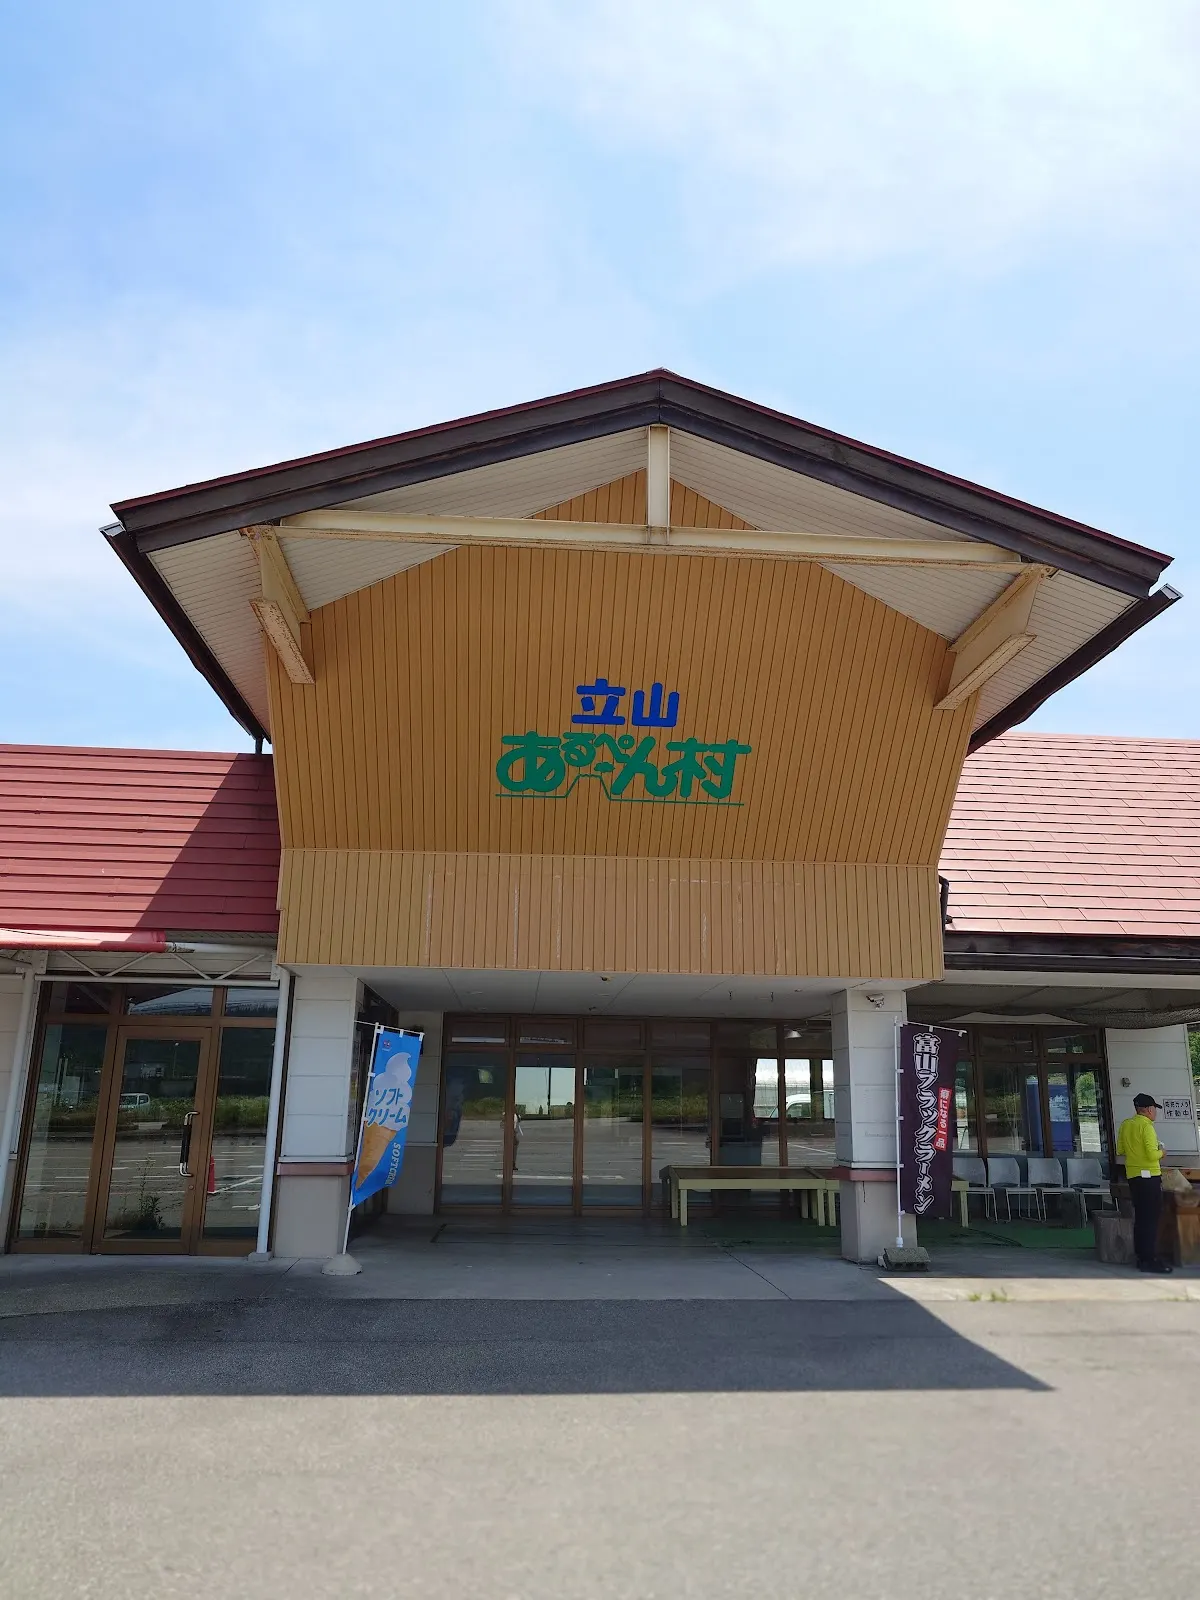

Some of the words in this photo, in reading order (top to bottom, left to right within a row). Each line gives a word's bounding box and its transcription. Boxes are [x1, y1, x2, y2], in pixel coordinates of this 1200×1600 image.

[571, 678, 680, 728] 立山
[495, 730, 752, 799] あるぺん村
[367, 1107, 407, 1127] クリーム
[375, 1087, 404, 1107] ソフト
[912, 1032, 941, 1216] 富山ブラックラーメン
